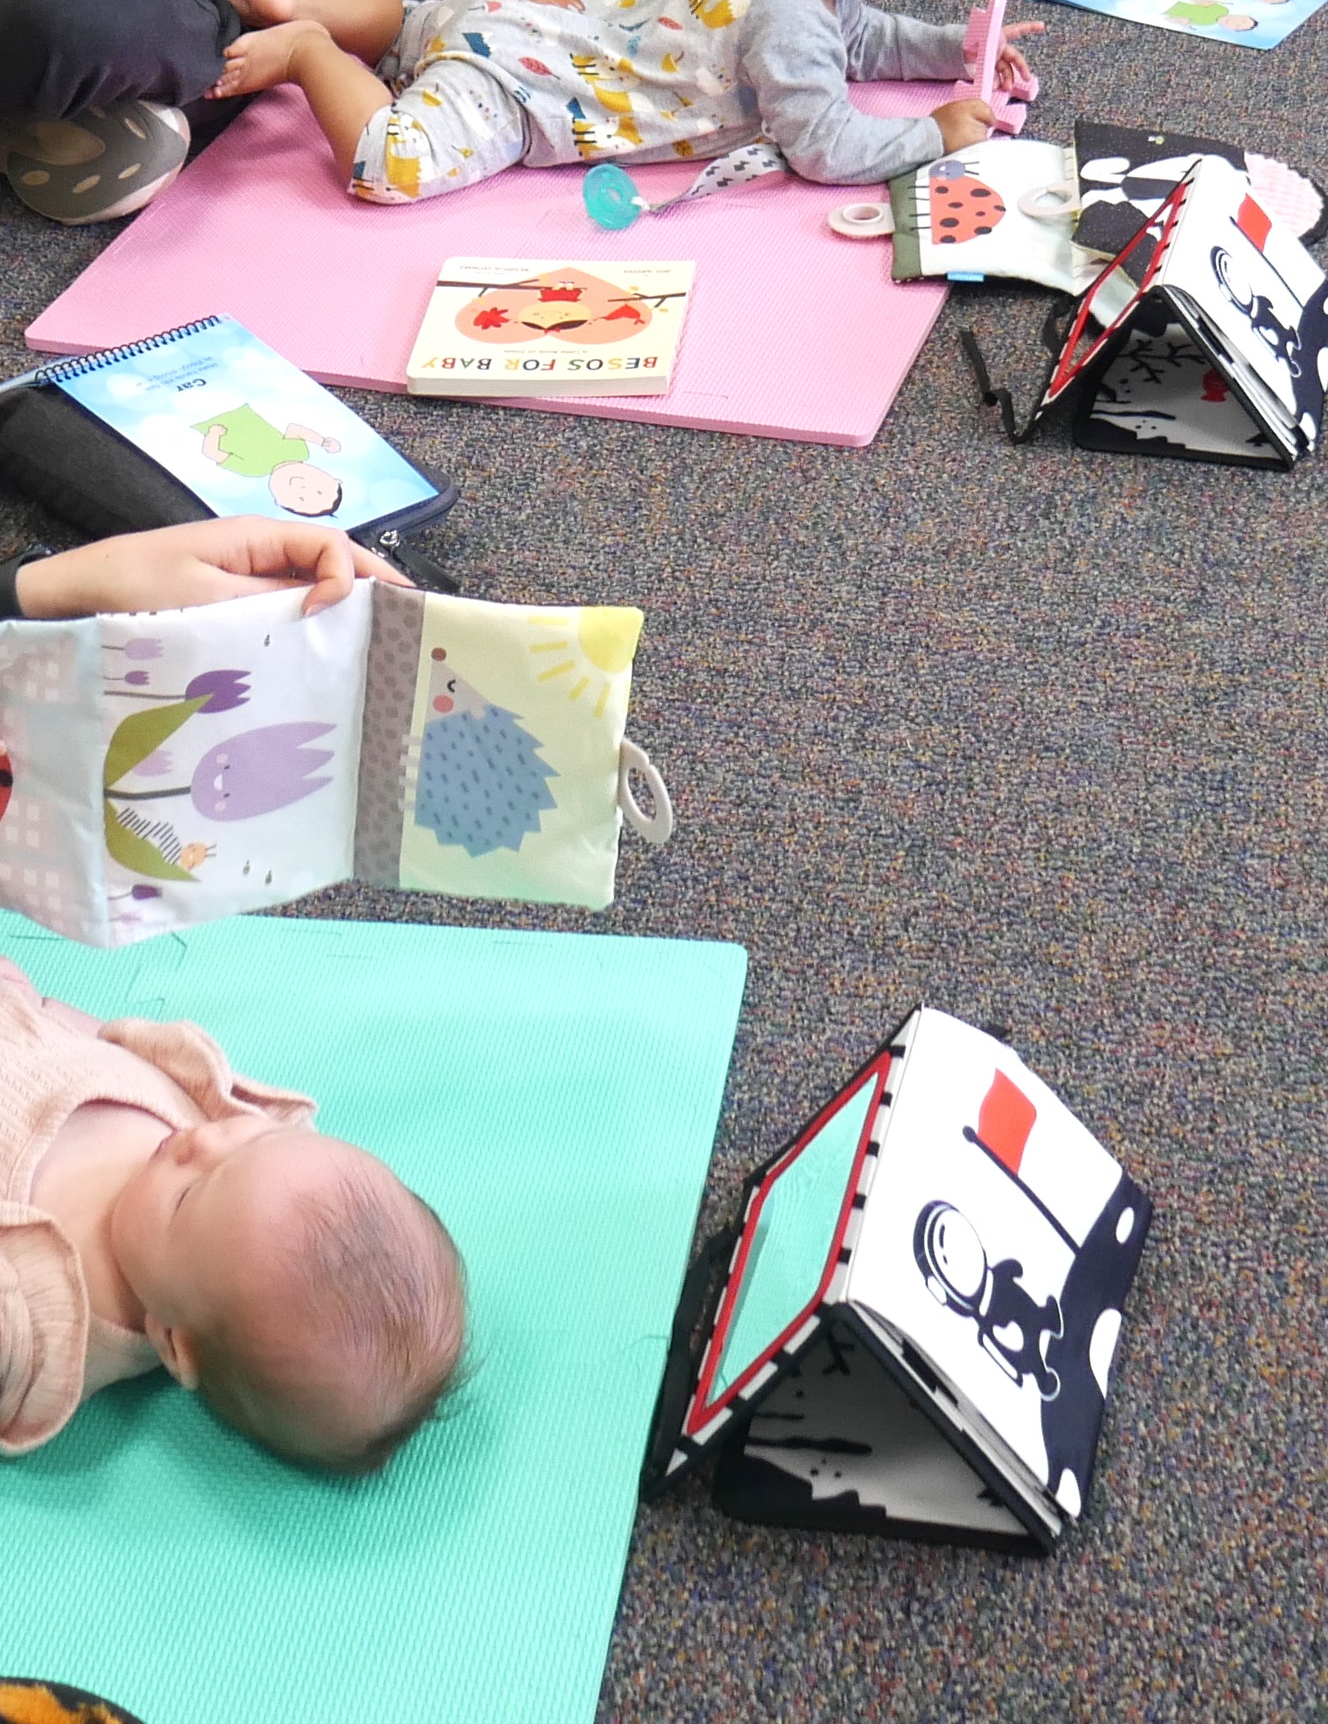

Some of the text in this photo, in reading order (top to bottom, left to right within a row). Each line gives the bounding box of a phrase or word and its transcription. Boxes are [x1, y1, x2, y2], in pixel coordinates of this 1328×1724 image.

[421, 356, 659, 372] BESOS FOR BABY
[176, 378, 207, 392] Car
